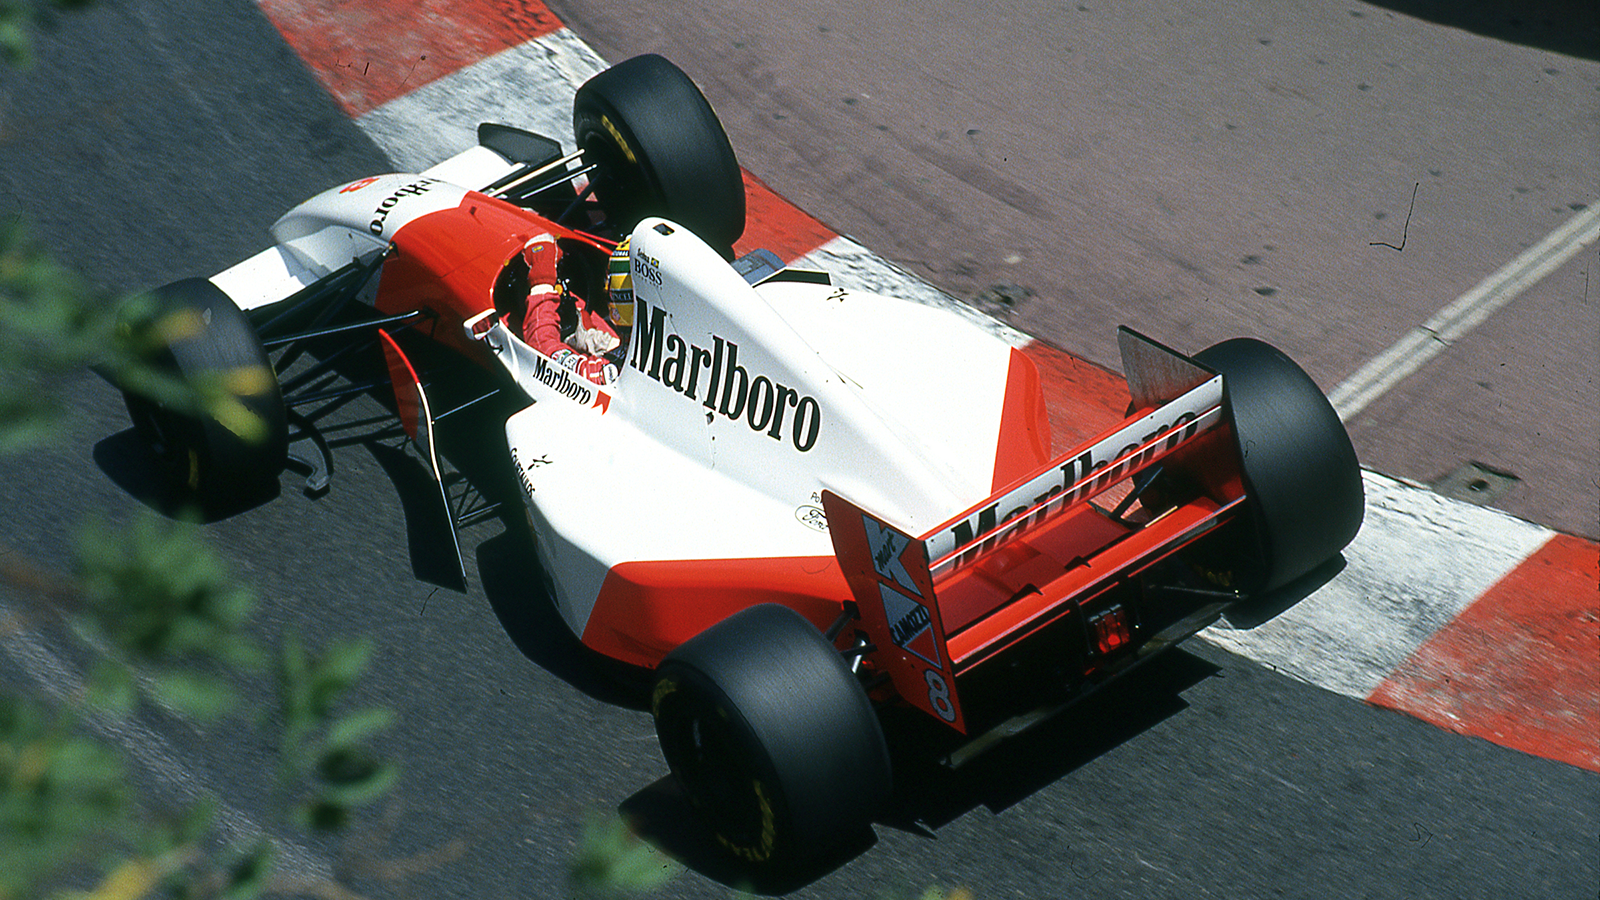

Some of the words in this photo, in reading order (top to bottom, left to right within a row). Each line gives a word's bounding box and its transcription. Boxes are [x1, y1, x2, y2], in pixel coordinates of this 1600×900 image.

[369, 178, 447, 236] rlboro
[634, 258, 662, 285] BOSS
[532, 355, 591, 405] Marlboro
[630, 295, 821, 452] Marlboro
[951, 412, 1199, 571] Marlboro
[925, 668, 956, 722] 8
